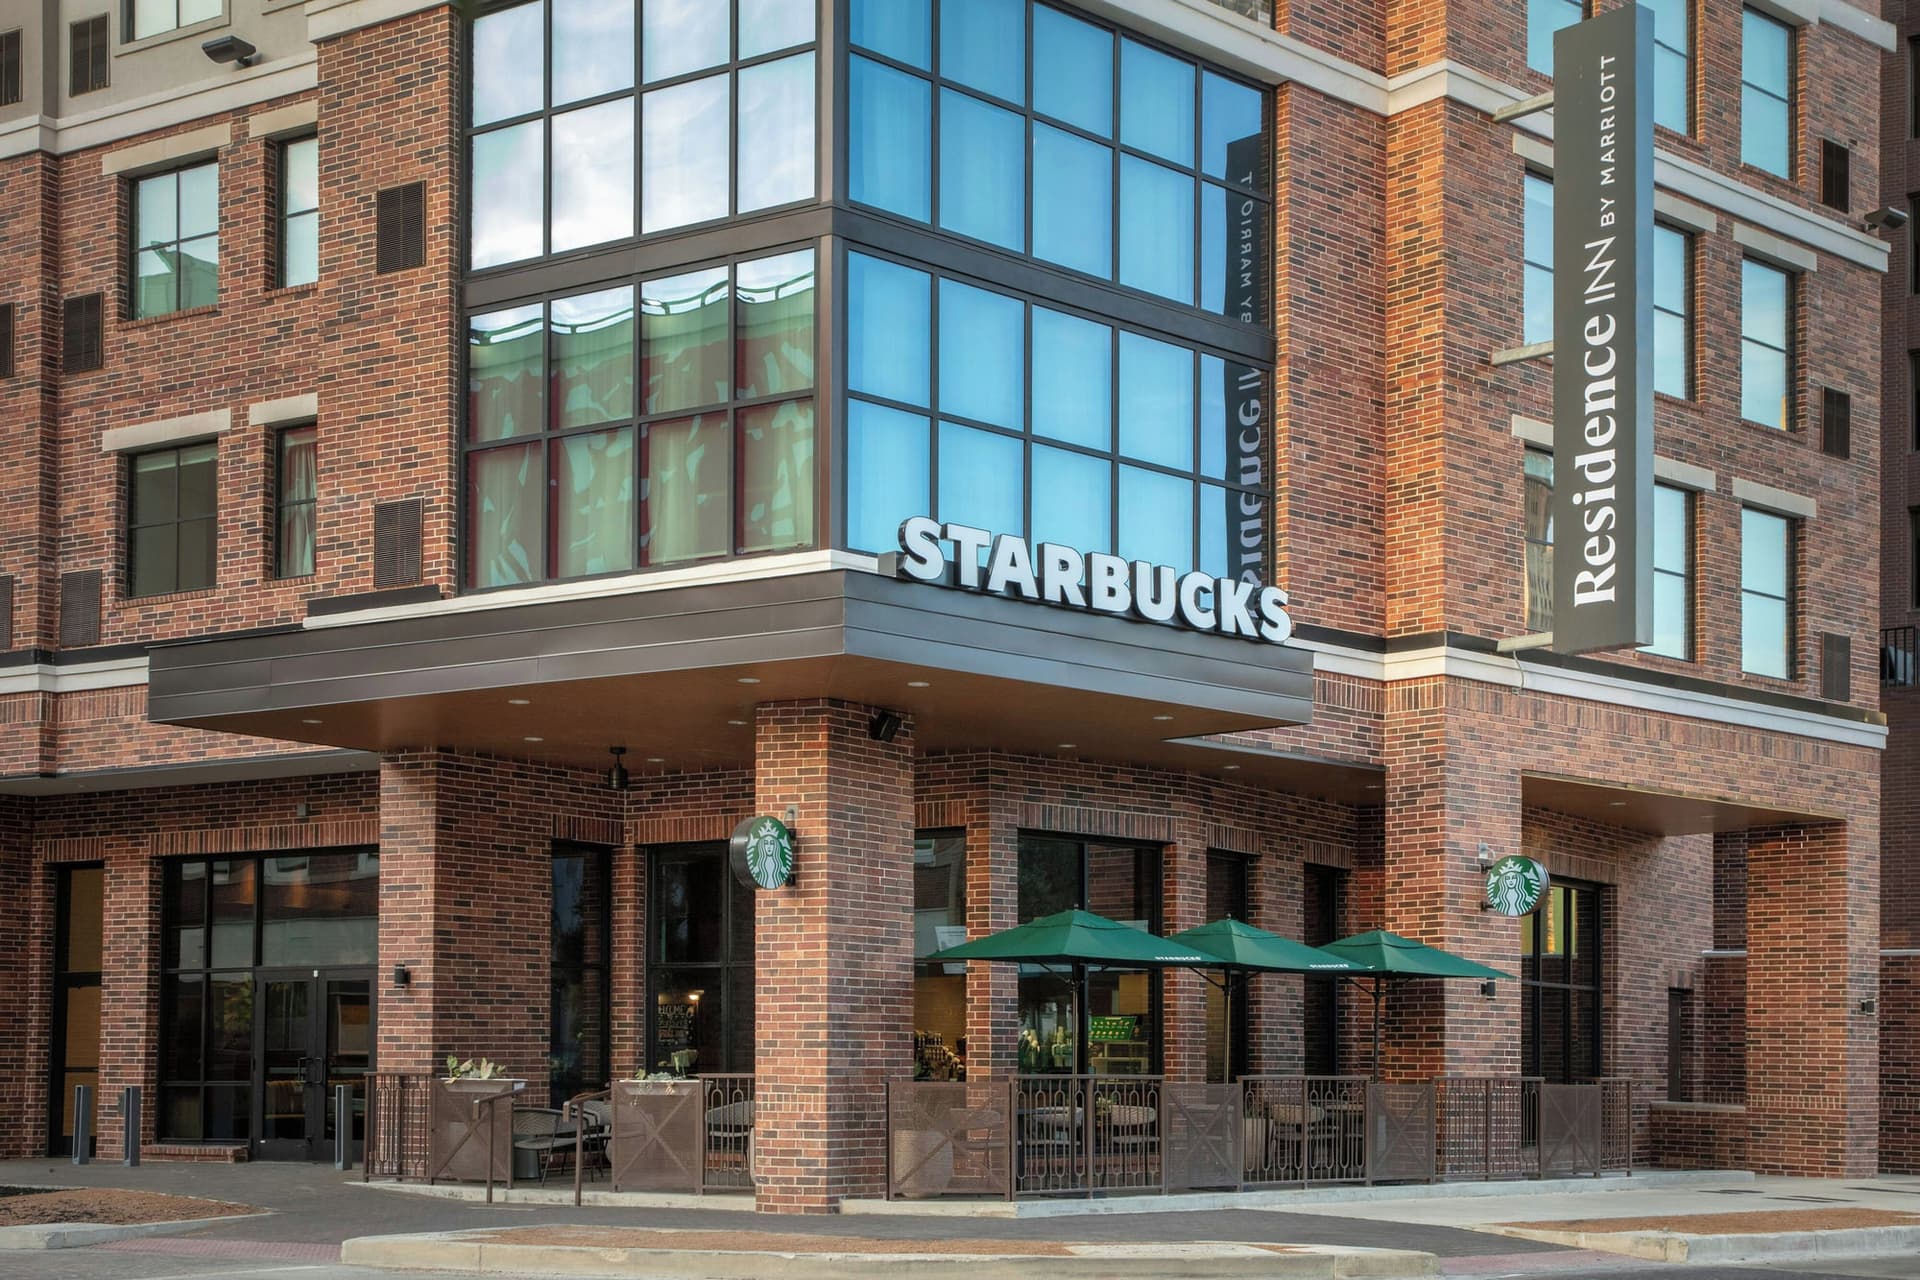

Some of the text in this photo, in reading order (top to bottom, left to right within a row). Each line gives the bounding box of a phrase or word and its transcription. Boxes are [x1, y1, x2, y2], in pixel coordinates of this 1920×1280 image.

[1572, 55, 1617, 607] Residence INN BY MARRIOTT
[899, 516, 1292, 643] STARBUCKS
